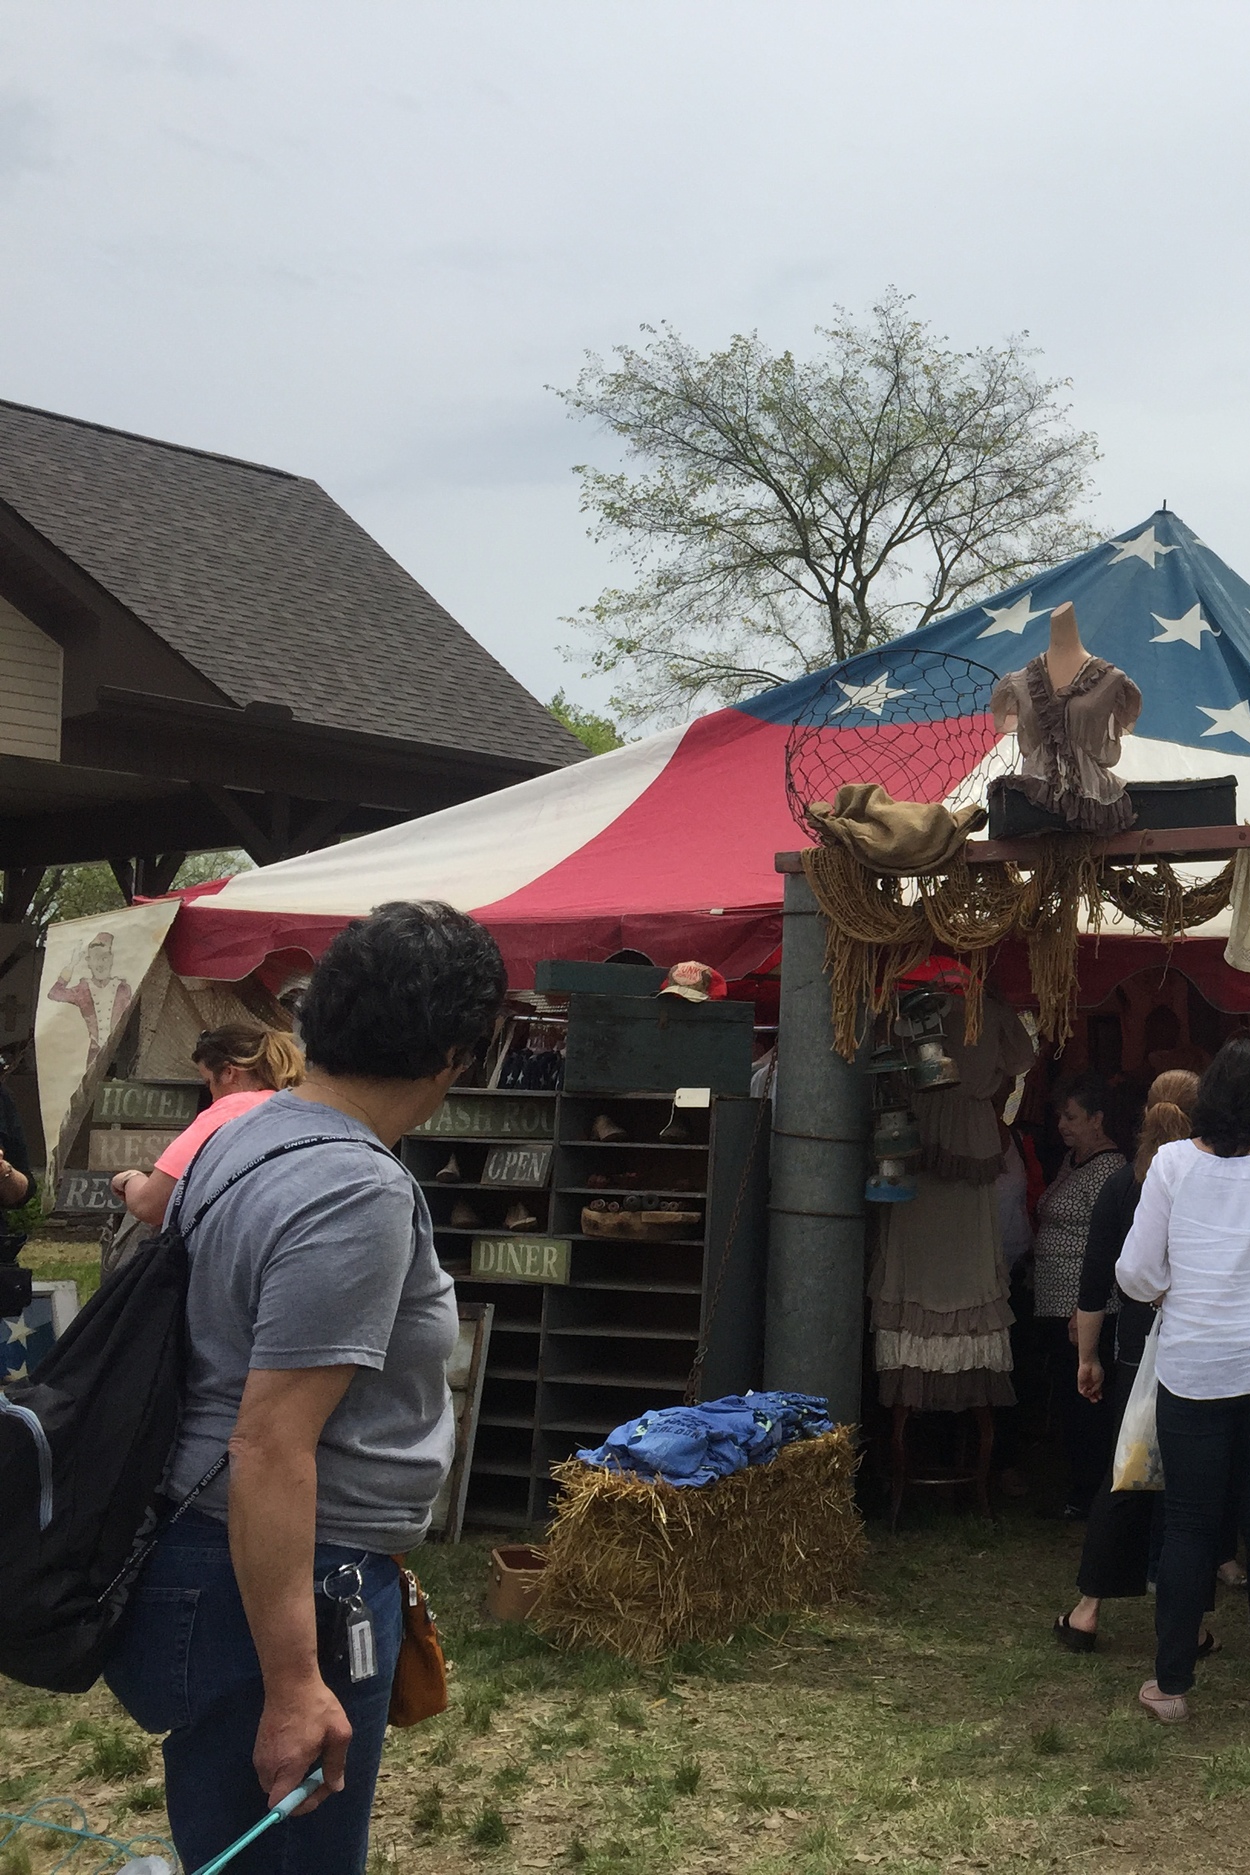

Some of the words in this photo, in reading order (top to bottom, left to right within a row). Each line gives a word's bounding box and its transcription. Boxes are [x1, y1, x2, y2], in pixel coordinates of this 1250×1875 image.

[100, 1087, 190, 1119] HOTEL
[488, 1151, 547, 1182] OPEN
[478, 1240, 559, 1278] DINER
[200, 1457, 226, 1487] UNDER
[169, 1487, 201, 1524] ARMOUR
